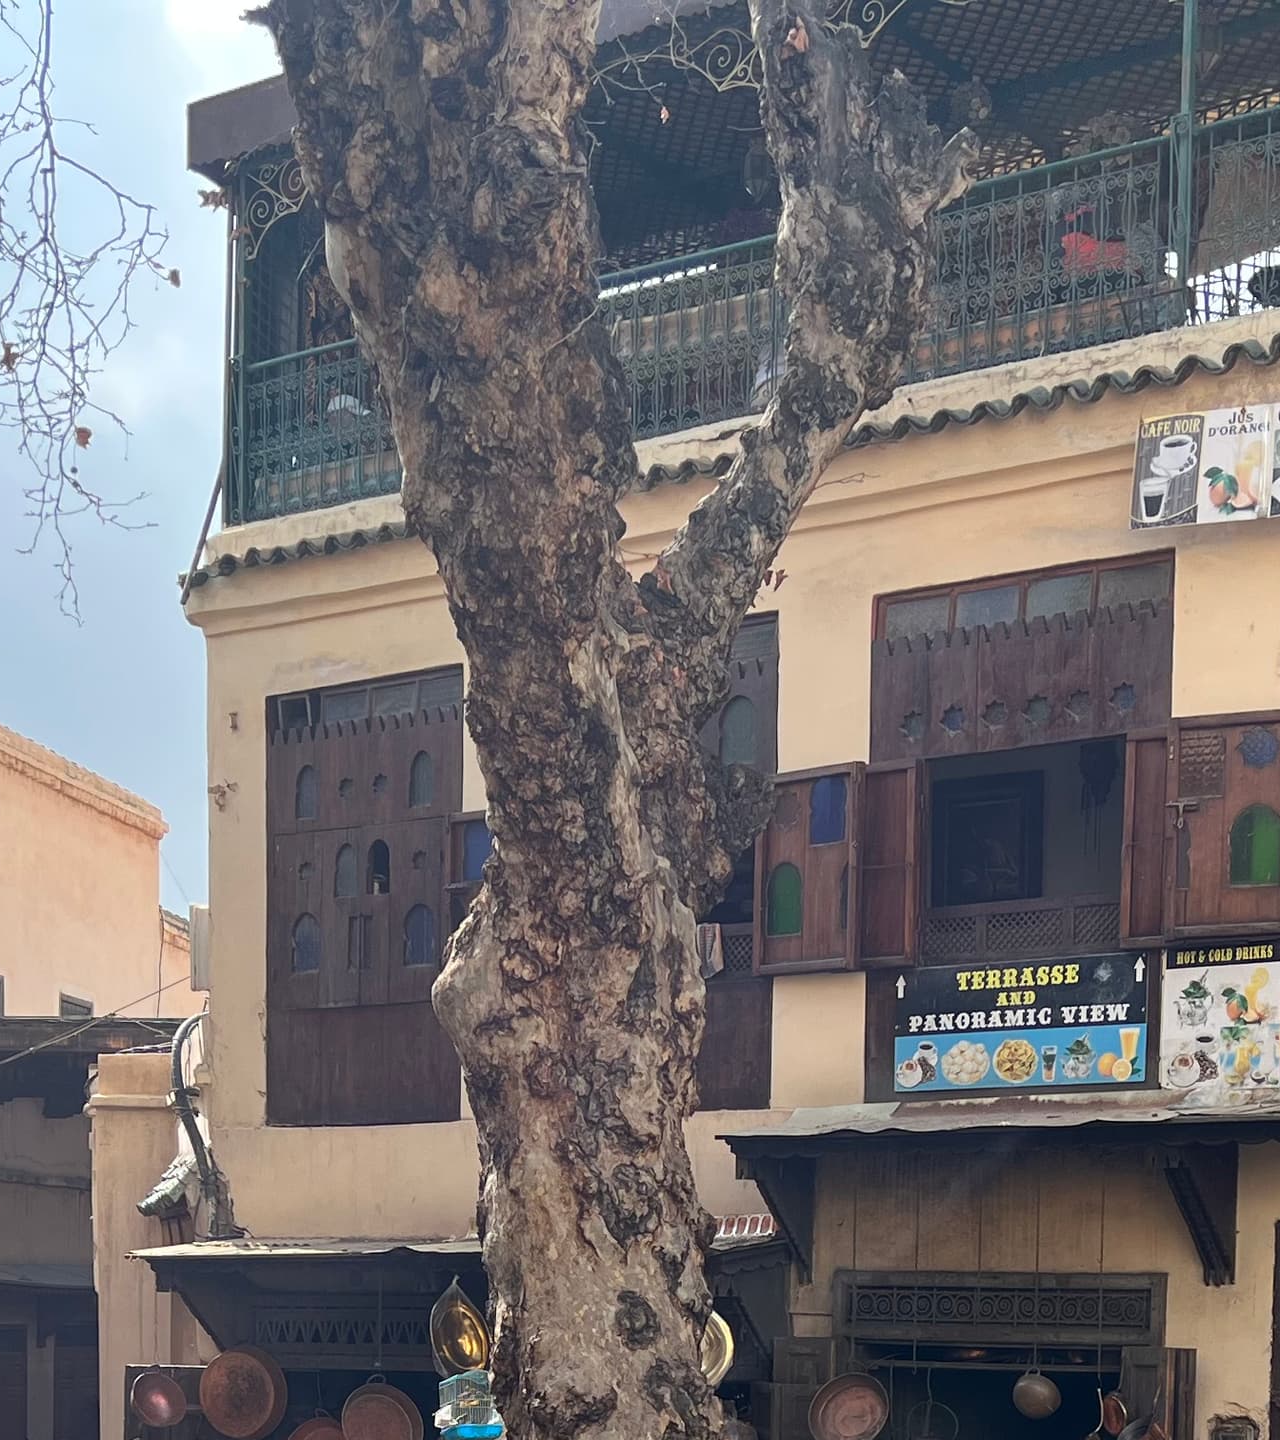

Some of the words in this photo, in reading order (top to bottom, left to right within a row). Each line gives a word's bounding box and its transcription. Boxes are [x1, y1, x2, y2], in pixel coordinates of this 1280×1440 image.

[1173, 417, 1201, 435] NOIR
[1208, 421, 1271, 438] D'ORANG
[1175, 951, 1197, 965] HOT
[1198, 950, 1206, 963] &
[1208, 948, 1233, 962] COLD
[1235, 944, 1274, 960] DRINKS
[956, 963, 1080, 991] TERRASSE
[996, 990, 1036, 1007] AND
[908, 1008, 1052, 1033] PANORAMIC
[1061, 1003, 1131, 1024] VIEW
